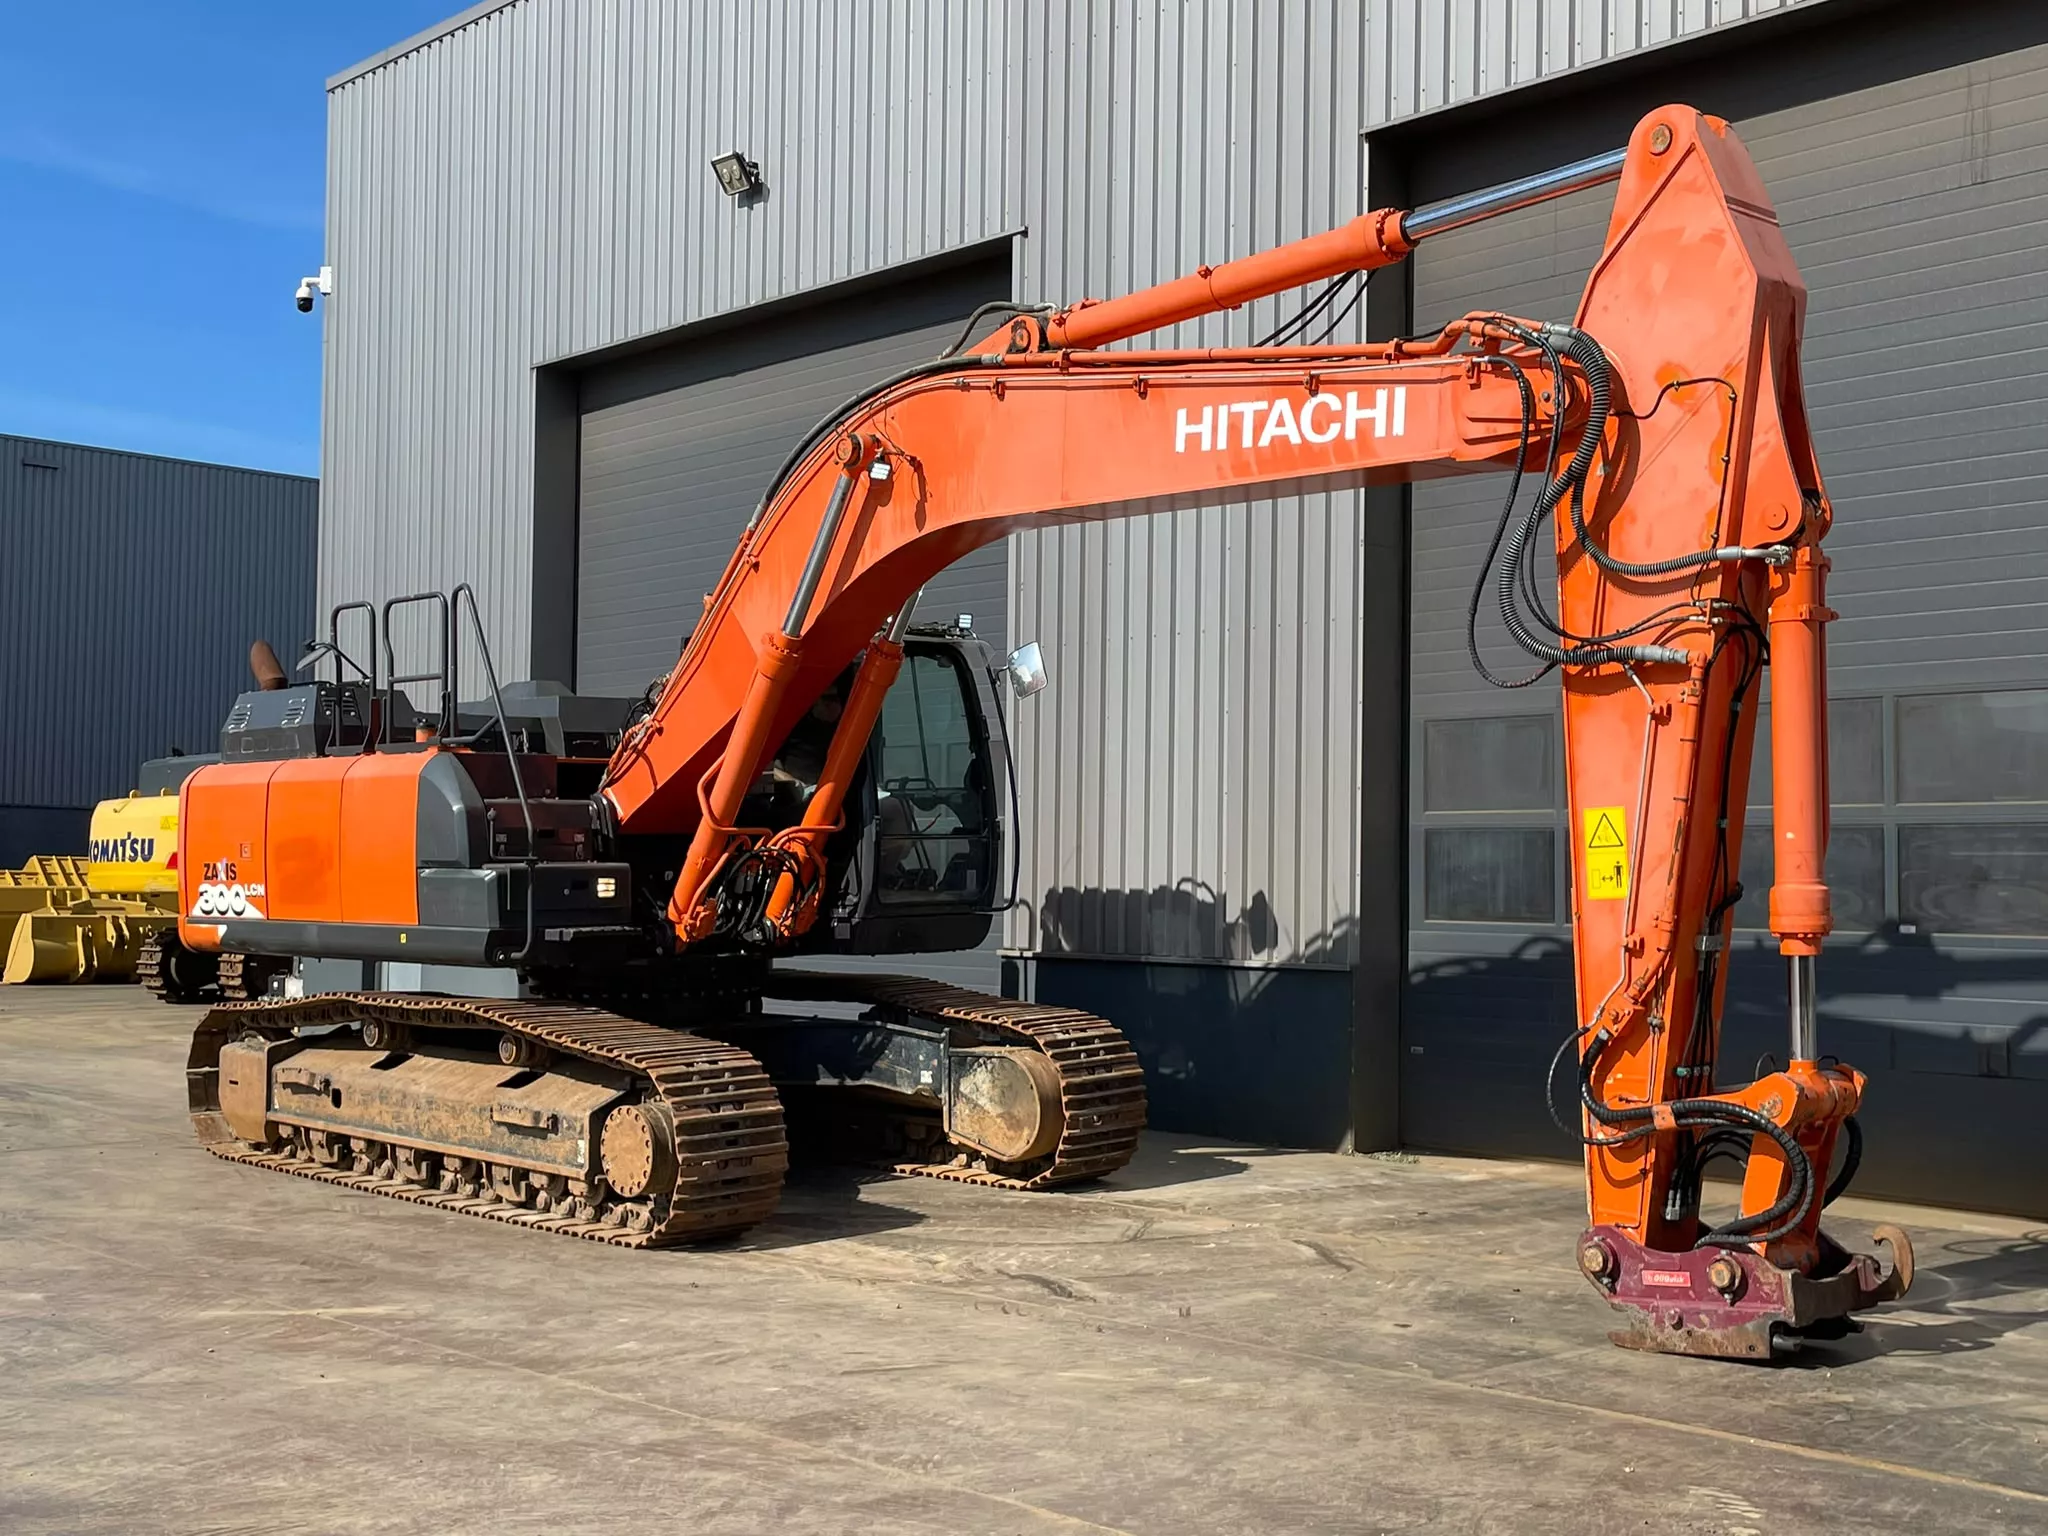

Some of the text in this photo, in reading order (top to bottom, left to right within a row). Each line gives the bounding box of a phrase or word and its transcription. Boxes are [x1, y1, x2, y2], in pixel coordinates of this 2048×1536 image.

[1175, 386, 1406, 453] HITACHI
[203, 858, 237, 881] ZAXIS
[199, 883, 246, 916] 300
